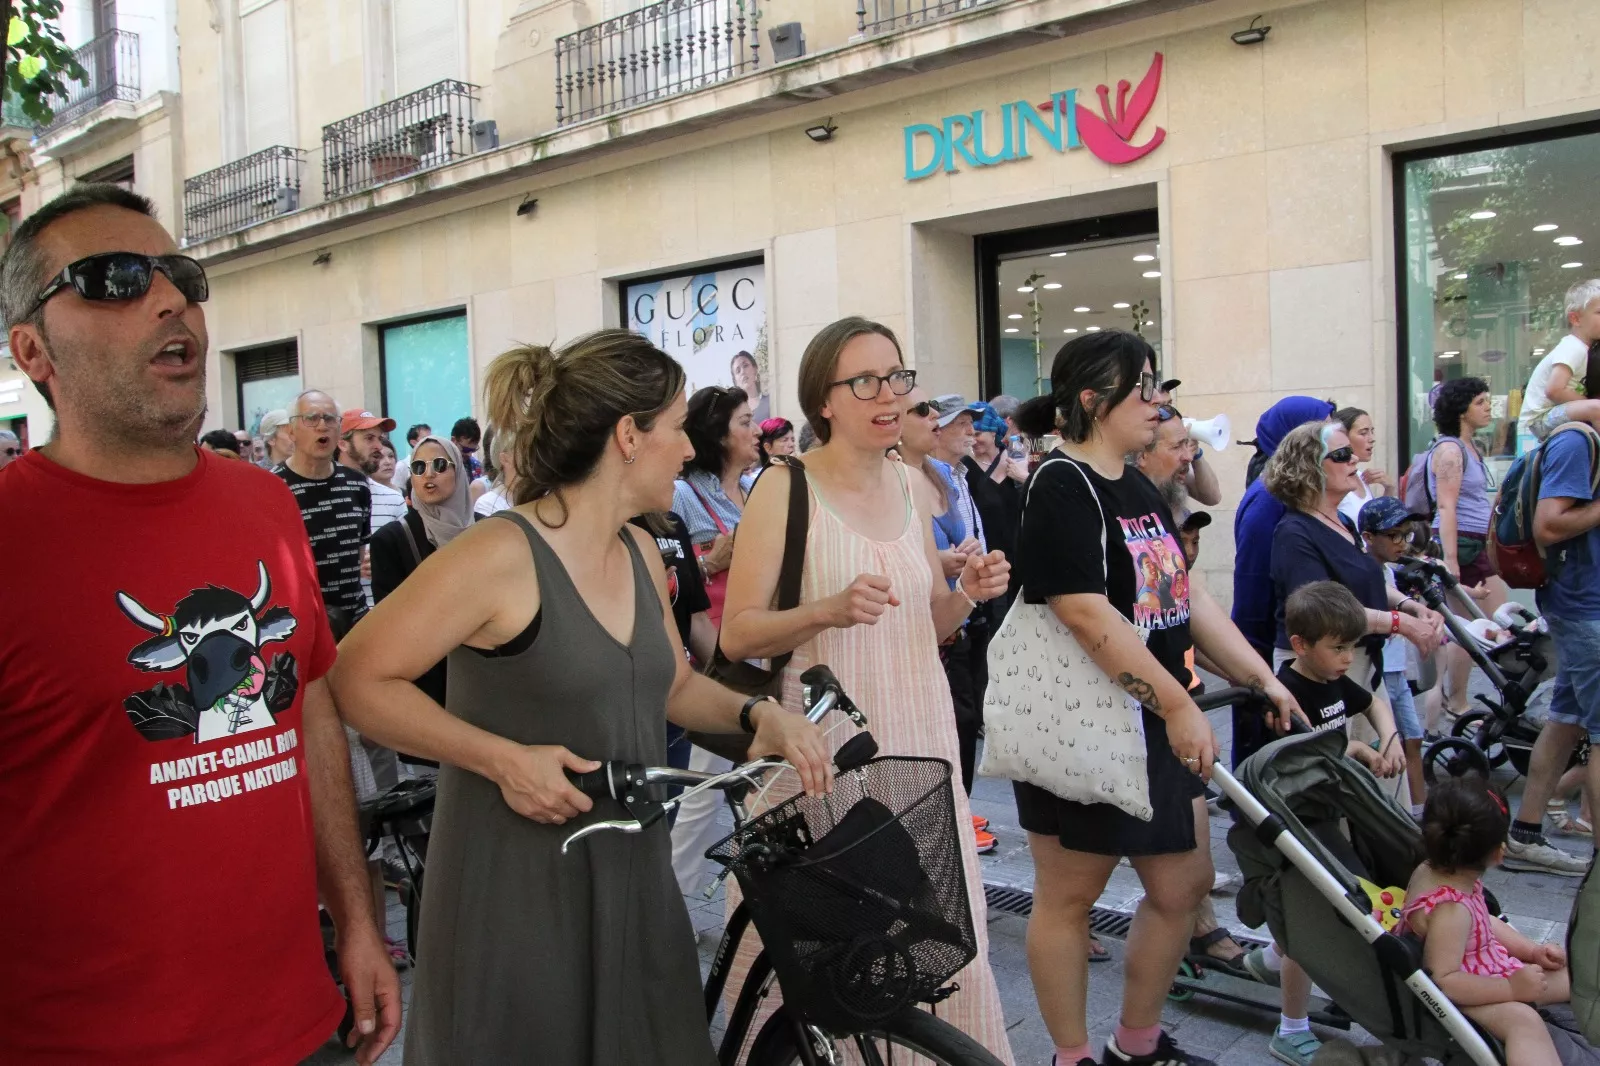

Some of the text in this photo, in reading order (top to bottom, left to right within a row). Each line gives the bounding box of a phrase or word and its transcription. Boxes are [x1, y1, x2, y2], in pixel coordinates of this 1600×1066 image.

[903, 88, 1081, 181] DRUNI
[661, 323, 744, 349] FLORA
[150, 738, 275, 785] ANAYET-CANAL
[167, 774, 243, 809] PARQUE
[1420, 990, 1447, 1019] mutsy
